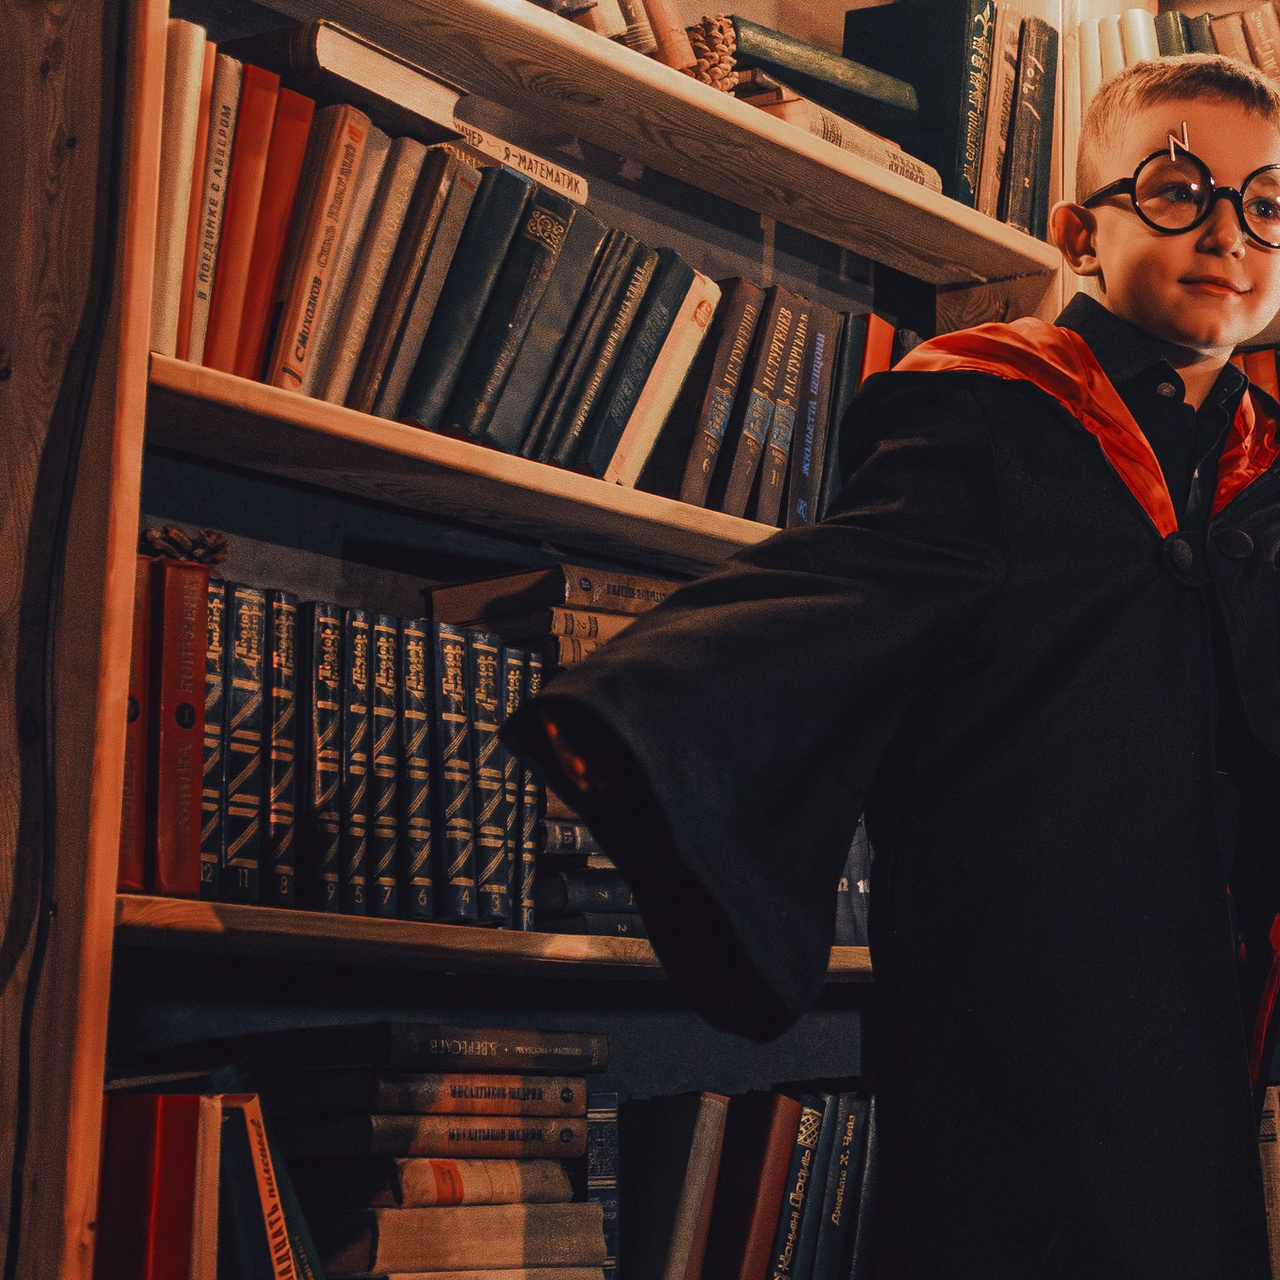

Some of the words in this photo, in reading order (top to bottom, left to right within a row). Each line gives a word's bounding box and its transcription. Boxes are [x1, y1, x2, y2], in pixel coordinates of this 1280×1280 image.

[197, 200, 220, 285] ПОЕДИНКЕ
[212, 103, 233, 175] АБВЕРОМ
[612, 298, 634, 331] ЗДЕСЬ
[724, 301, 760, 387] И.С.ТУРГЕНЕВ
[761, 305, 794, 391] И.С.ТУРГЕНЕВ
[782, 312, 809, 397] И.С.ТУРГЕНЕВ
[800, 400, 818, 476] ЖЮЛЬЕТТА
[281, 876, 288, 895] 8
[327, 882, 335, 901] 9
[355, 883, 363, 903] 5
[383, 886, 392, 904] 7
[418, 891, 427, 911] 6
[462, 892, 470, 911] 4
[491, 894, 500, 915] 3
[842, 1114, 859, 1147] Чейз
